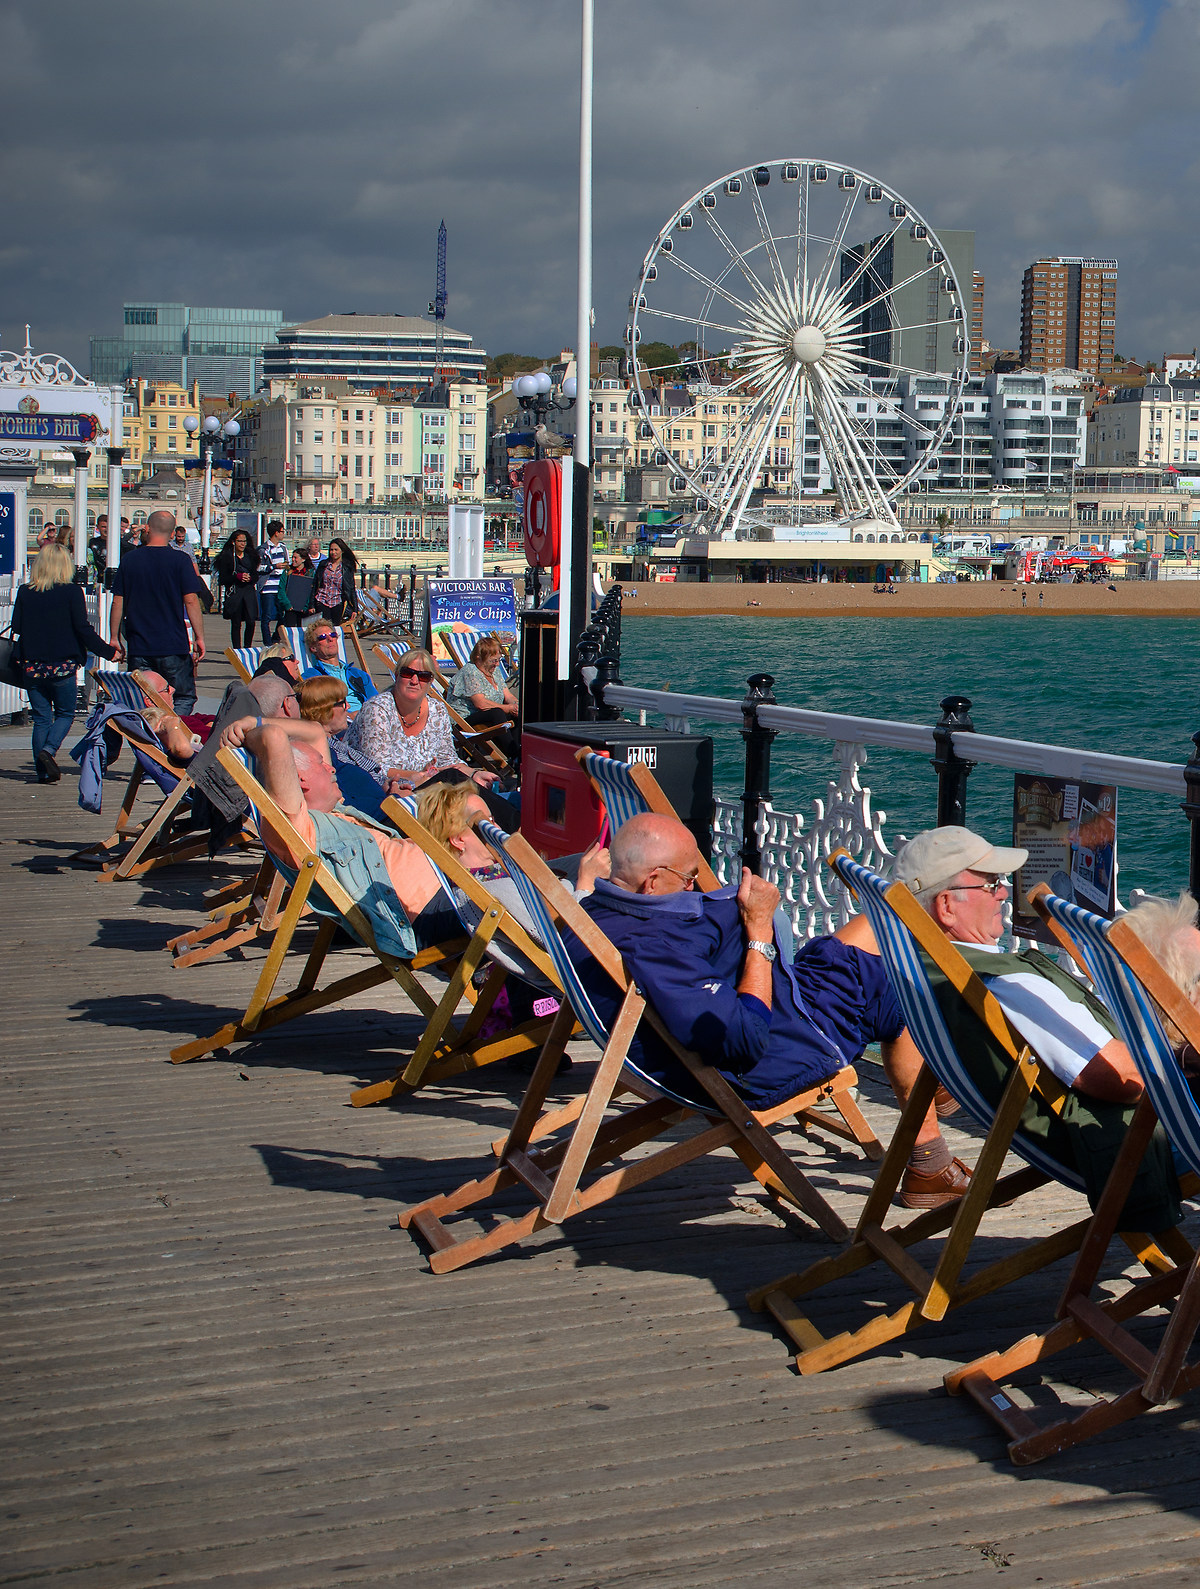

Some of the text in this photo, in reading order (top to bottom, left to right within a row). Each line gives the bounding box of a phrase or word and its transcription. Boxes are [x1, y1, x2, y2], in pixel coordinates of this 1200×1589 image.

[54, 418, 80, 437] BAR
[437, 582, 507, 593] VICTORIA'S BAR
[436, 607, 512, 623] Fish & Chips
